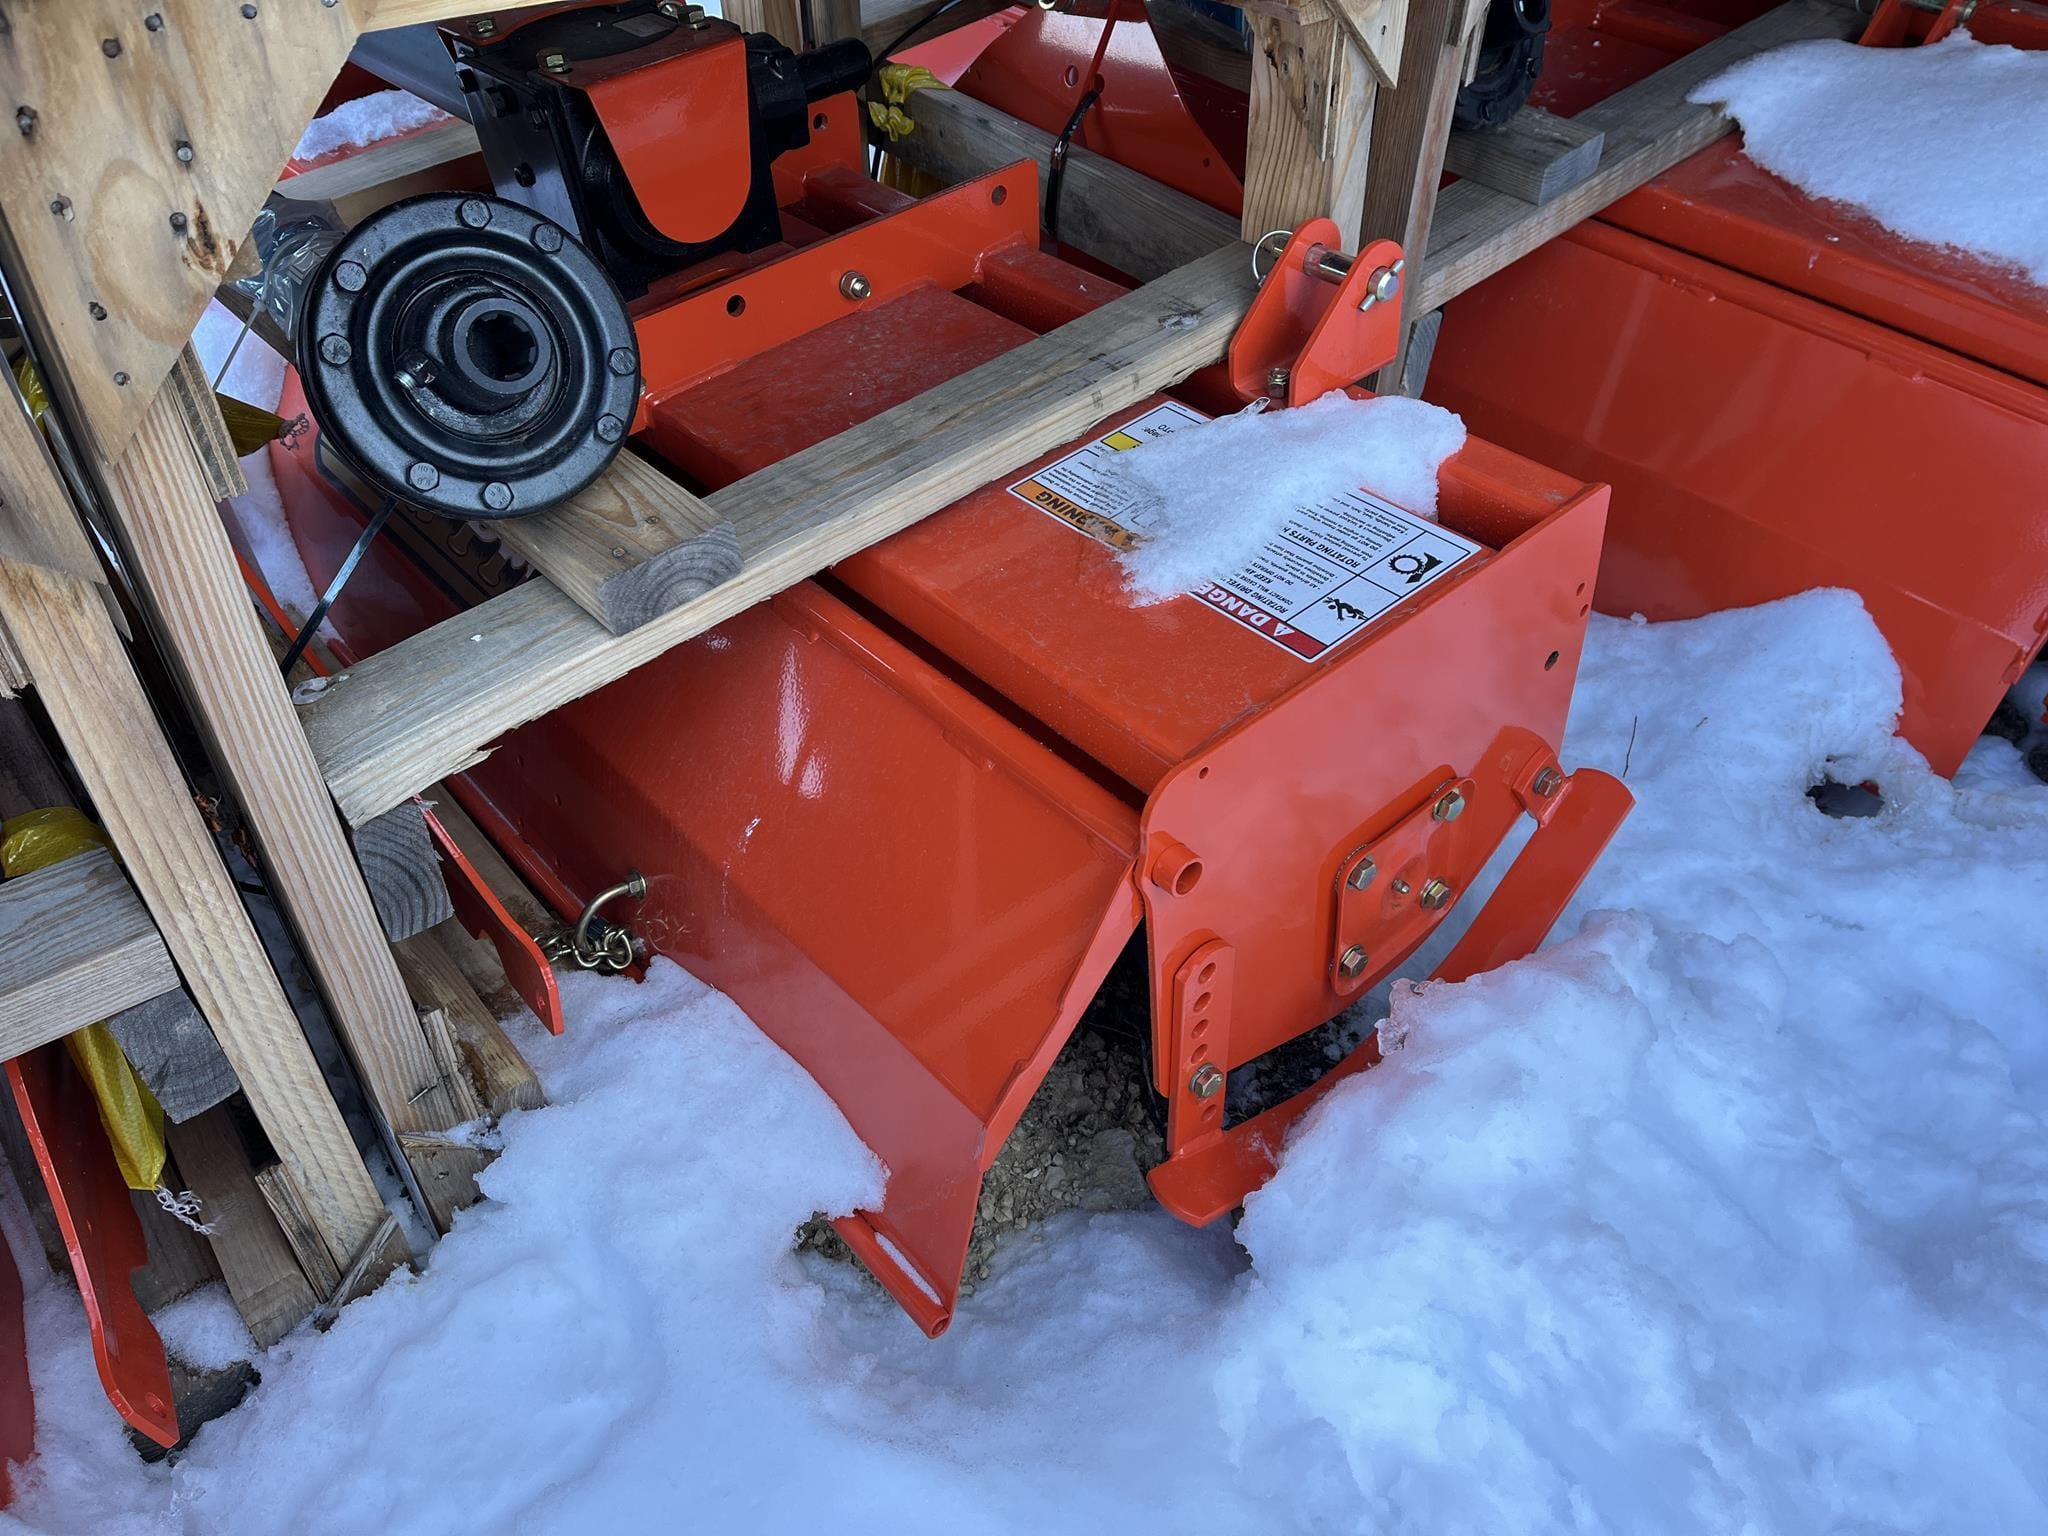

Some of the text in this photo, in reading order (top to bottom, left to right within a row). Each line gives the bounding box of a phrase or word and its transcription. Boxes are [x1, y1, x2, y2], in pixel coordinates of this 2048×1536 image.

[1033, 490, 1119, 538] WRNING
[1288, 530, 1361, 568] ROTATING PARTS
[1250, 562, 1275, 575] OPERATE
[1252, 572, 1273, 584] KEEP
[1272, 573, 1286, 581] NOT
[1192, 581, 1272, 626] DANGE
[1219, 575, 1288, 613] ROTATING DRIVEL
[1239, 575, 1294, 605] CONTACT WILL CAUSE
